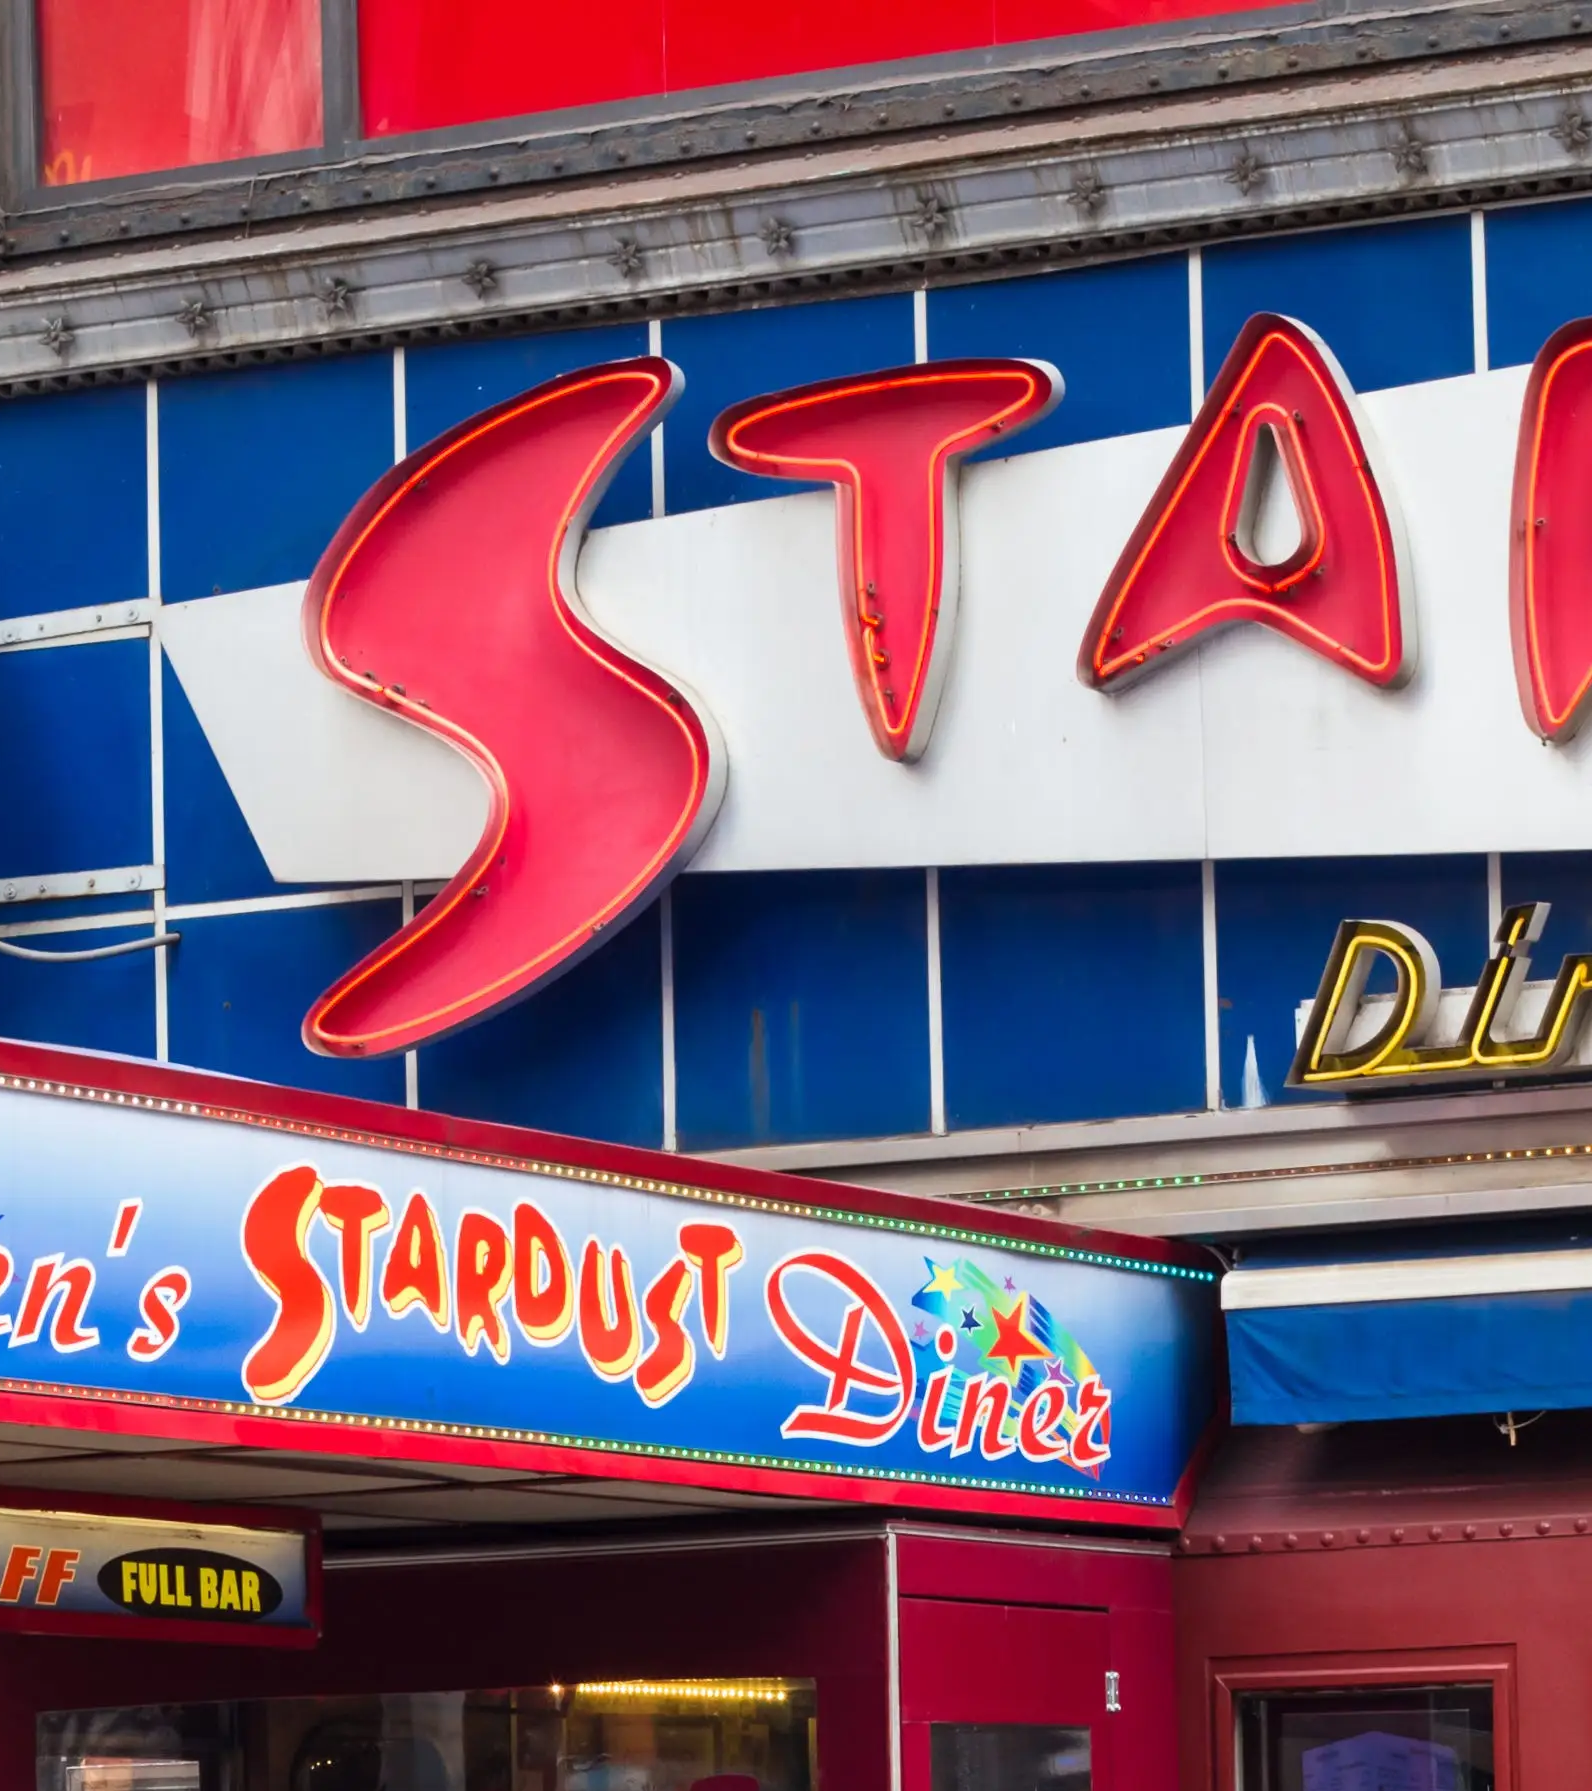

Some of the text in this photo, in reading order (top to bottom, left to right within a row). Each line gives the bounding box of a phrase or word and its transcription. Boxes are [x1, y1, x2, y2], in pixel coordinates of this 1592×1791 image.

[240, 1161, 743, 1408] STARDUST
[763, 1248, 1113, 1467] Diner
[120, 1560, 262, 1613] FULL BAR
